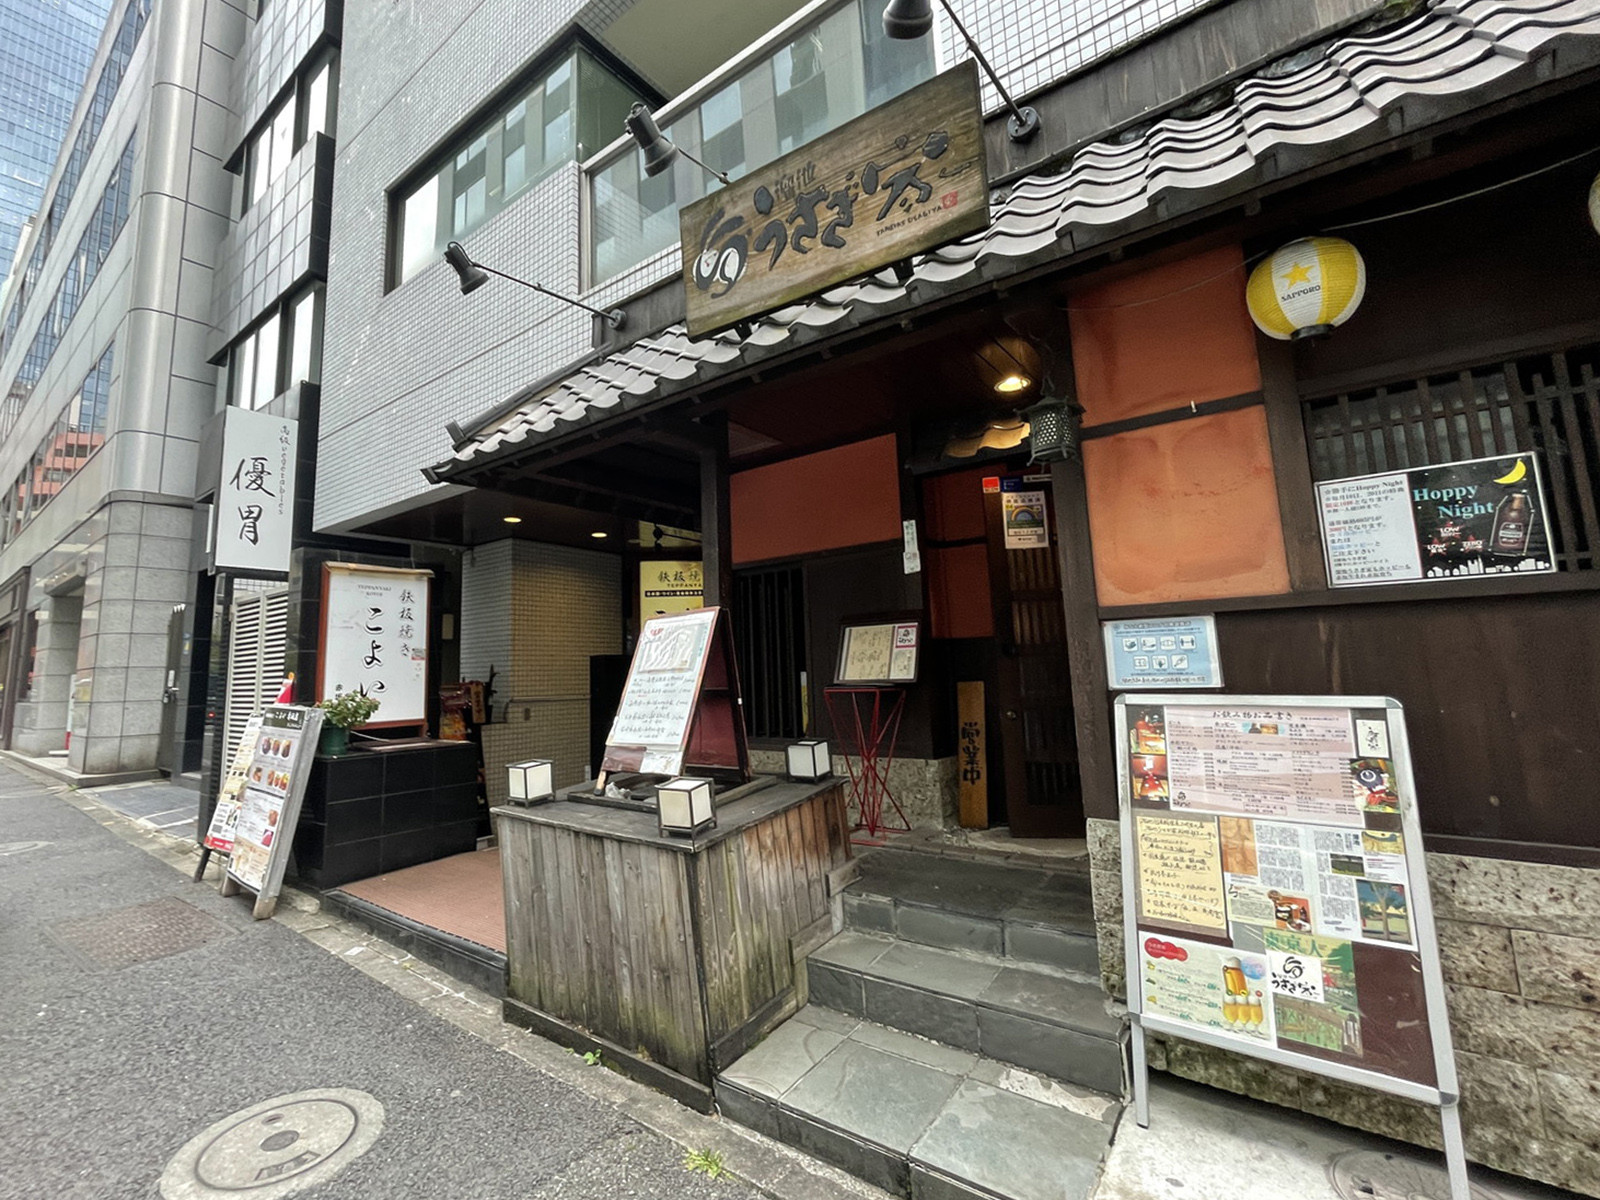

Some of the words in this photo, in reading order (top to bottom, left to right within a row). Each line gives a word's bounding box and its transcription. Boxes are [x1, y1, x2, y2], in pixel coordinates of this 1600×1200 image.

[1281, 284, 1321, 301] SAPPORO
[1413, 485, 1478, 502] Hoppy
[1438, 501, 1494, 519] Night
[1440, 526, 1460, 534] LOW
[400, 589, 415, 656] 鉄板焼き
[360, 607, 386, 698] こよい
[961, 721, 981, 785] 営業中
